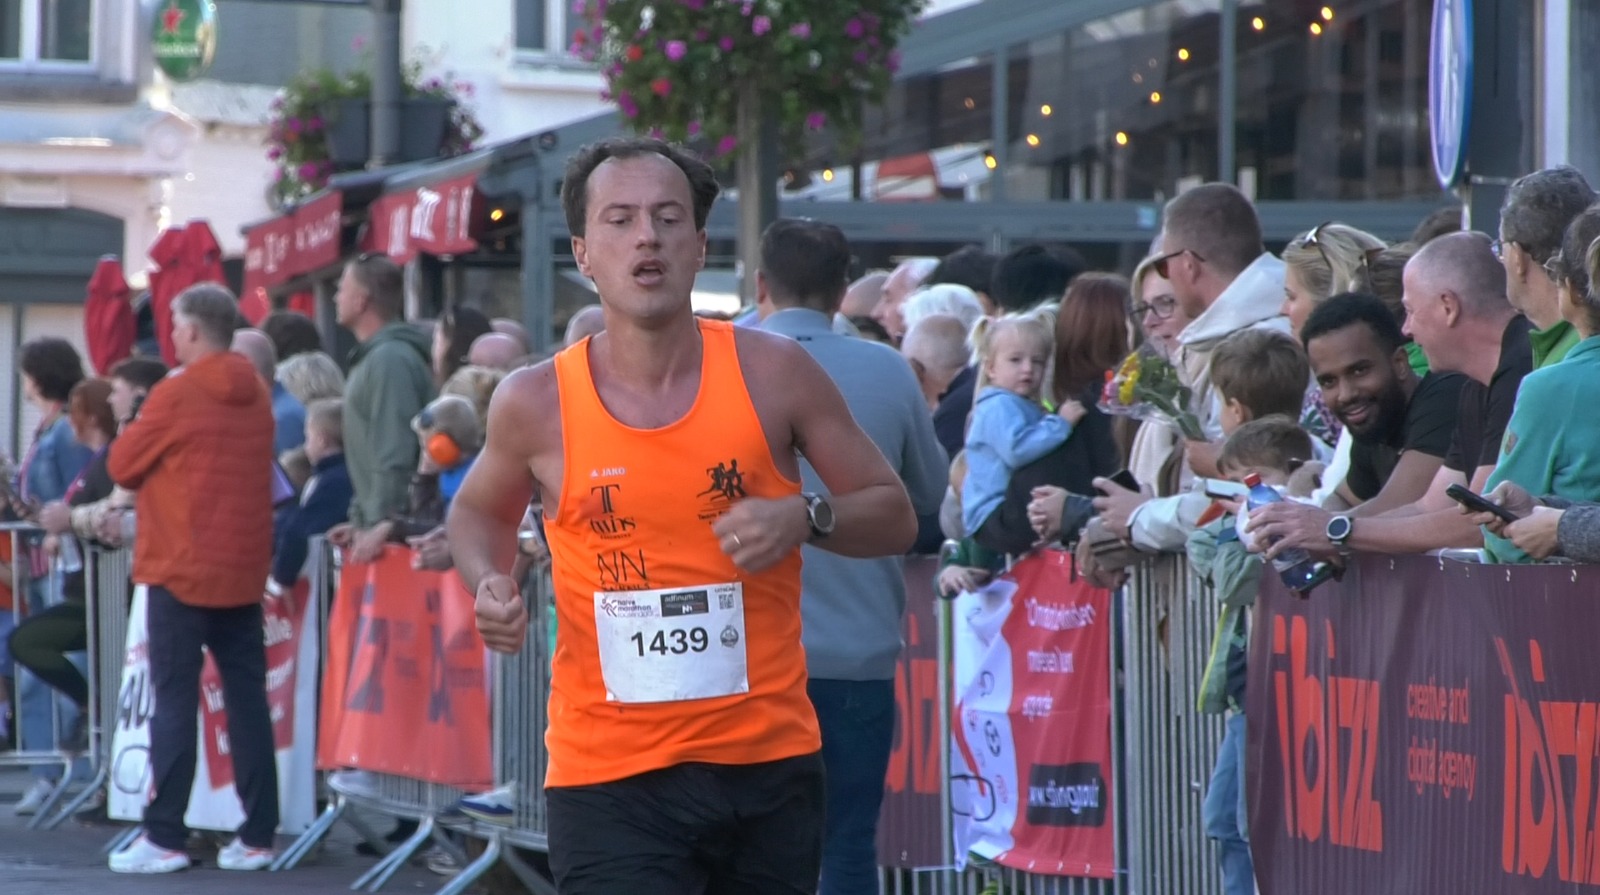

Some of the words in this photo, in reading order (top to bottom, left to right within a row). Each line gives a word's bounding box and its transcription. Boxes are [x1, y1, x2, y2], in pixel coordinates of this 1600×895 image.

[601, 467, 626, 476] JAKO
[591, 484, 621, 514] T
[589, 514, 637, 535] twins
[617, 604, 652, 612] marathon
[664, 594, 694, 603] adfinum
[631, 627, 709, 657] 1439
[1407, 674, 1447, 722] creative
[1448, 678, 1470, 724] and
[1407, 735, 1437, 796] digital
[1438, 749, 1478, 802] agency
